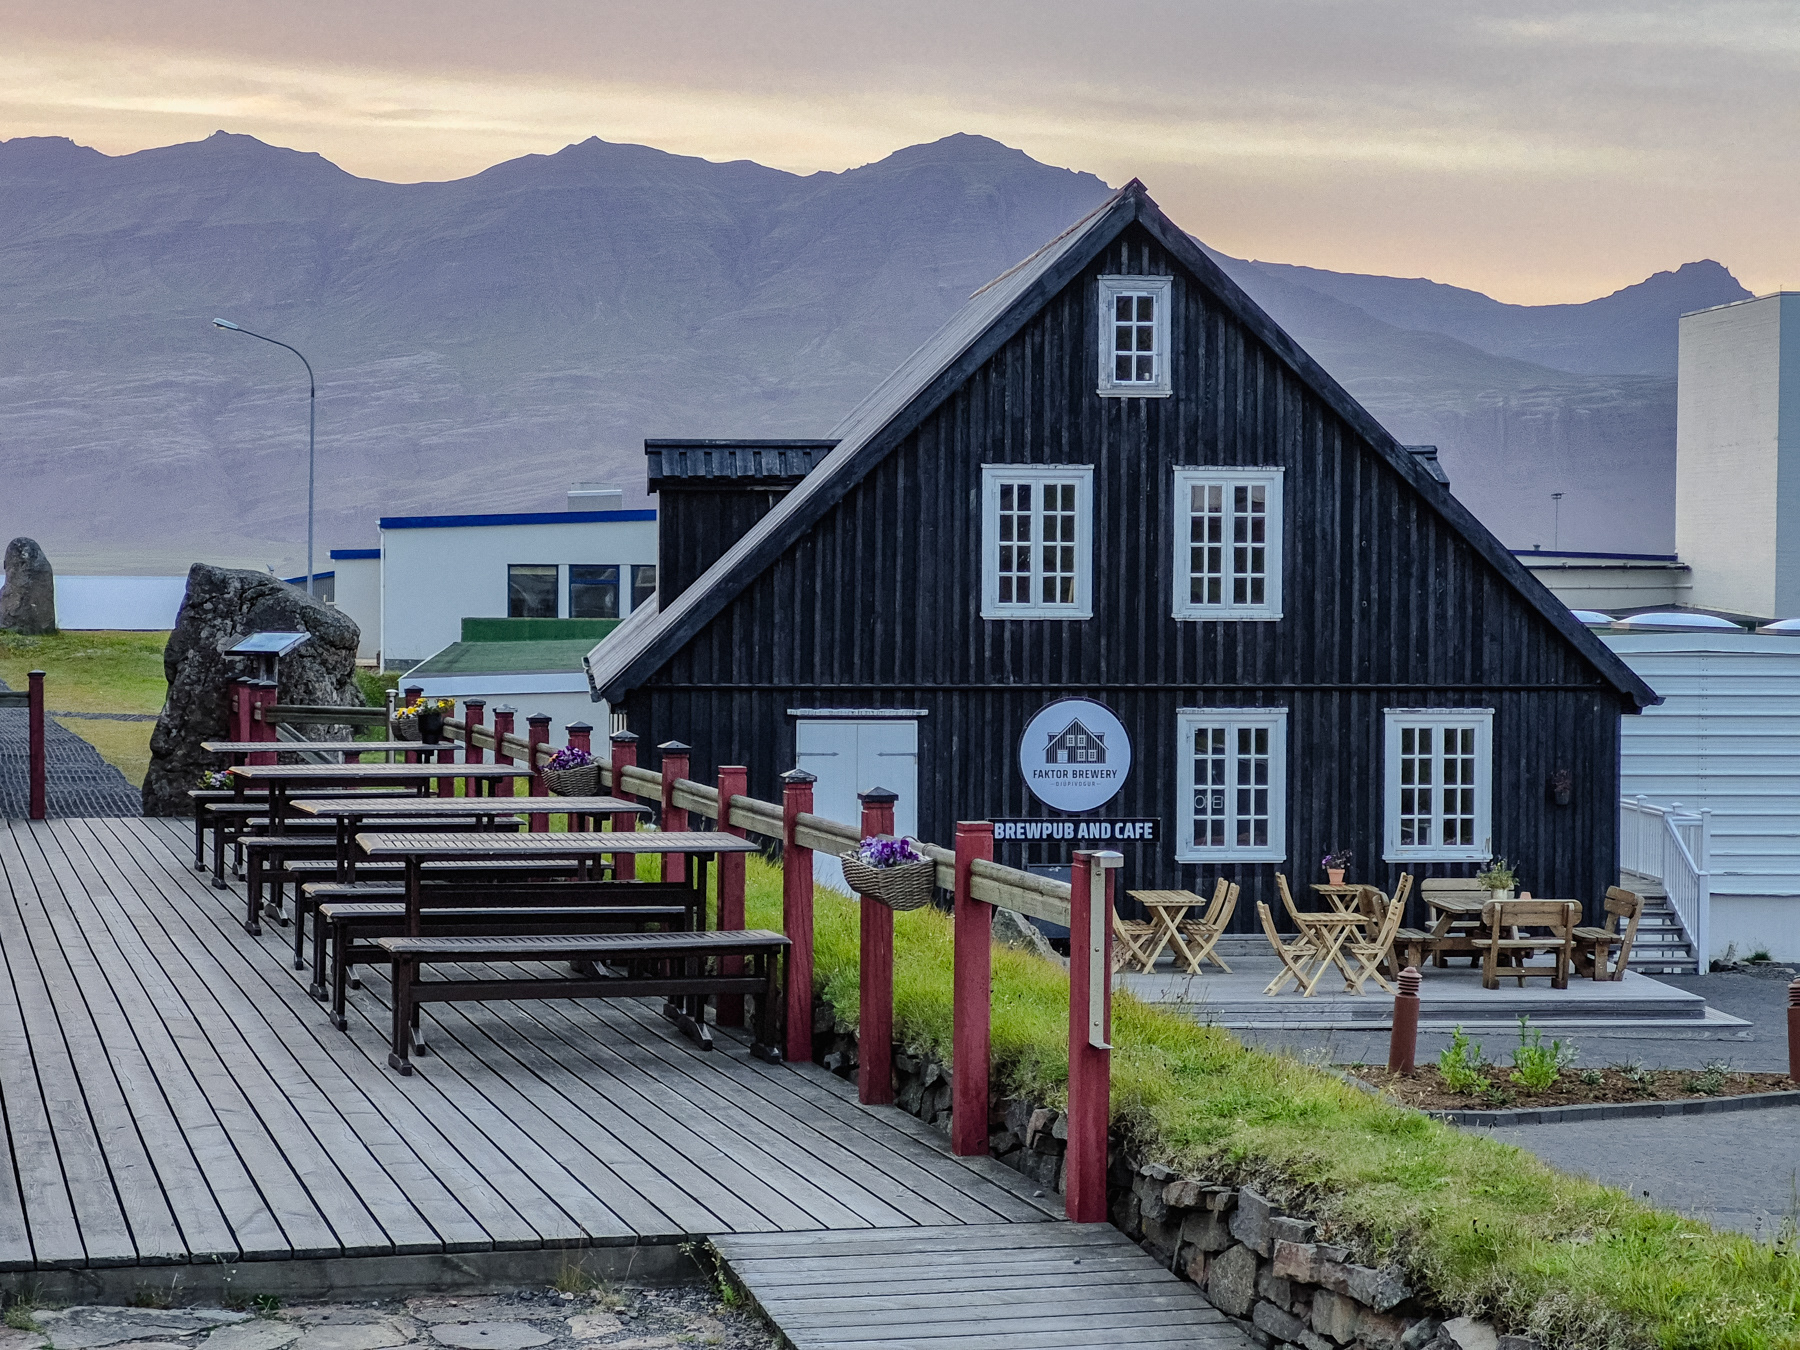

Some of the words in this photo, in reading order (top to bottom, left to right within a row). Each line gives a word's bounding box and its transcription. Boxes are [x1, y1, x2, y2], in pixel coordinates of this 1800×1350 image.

[1033, 769, 1069, 779] FAKTOR
[1072, 769, 1118, 779] BREWERY
[994, 822, 1074, 839] BREWPUB
[1078, 822, 1111, 839] AND
[1115, 822, 1153, 839] CAFE
